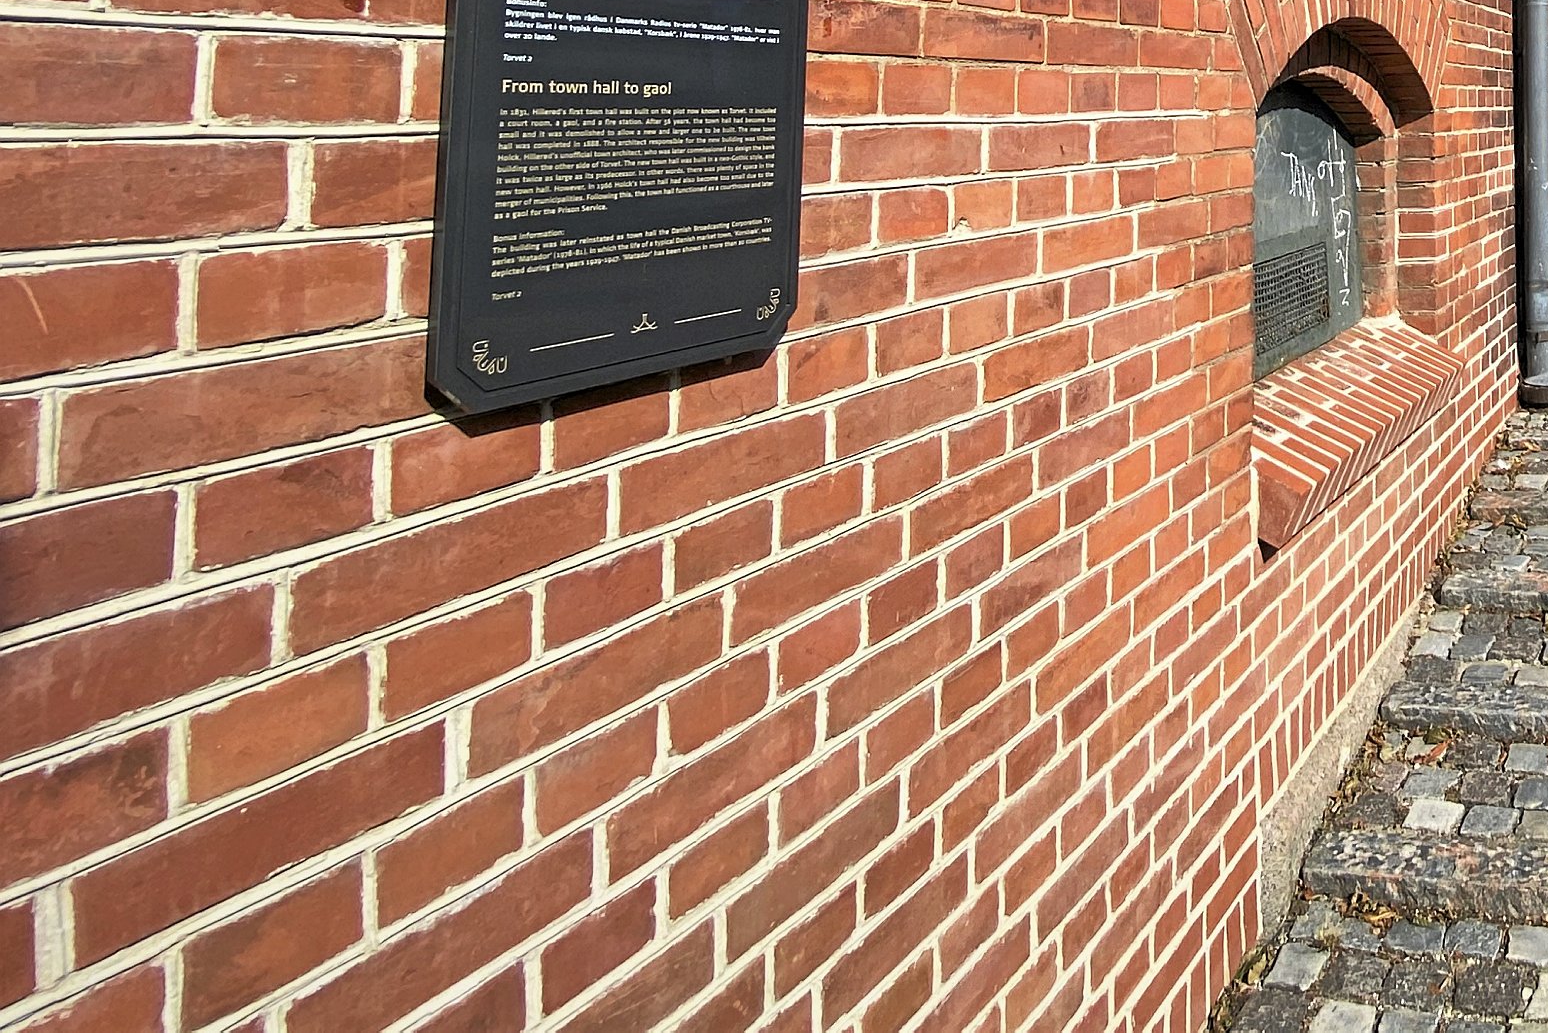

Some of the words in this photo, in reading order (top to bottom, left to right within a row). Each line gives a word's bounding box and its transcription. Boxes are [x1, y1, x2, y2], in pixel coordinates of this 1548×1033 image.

[502, 78, 544, 94] From
[549, 80, 588, 94] town
[593, 79, 620, 95] hall
[624, 81, 640, 95] to
[643, 81, 672, 98] gaol
